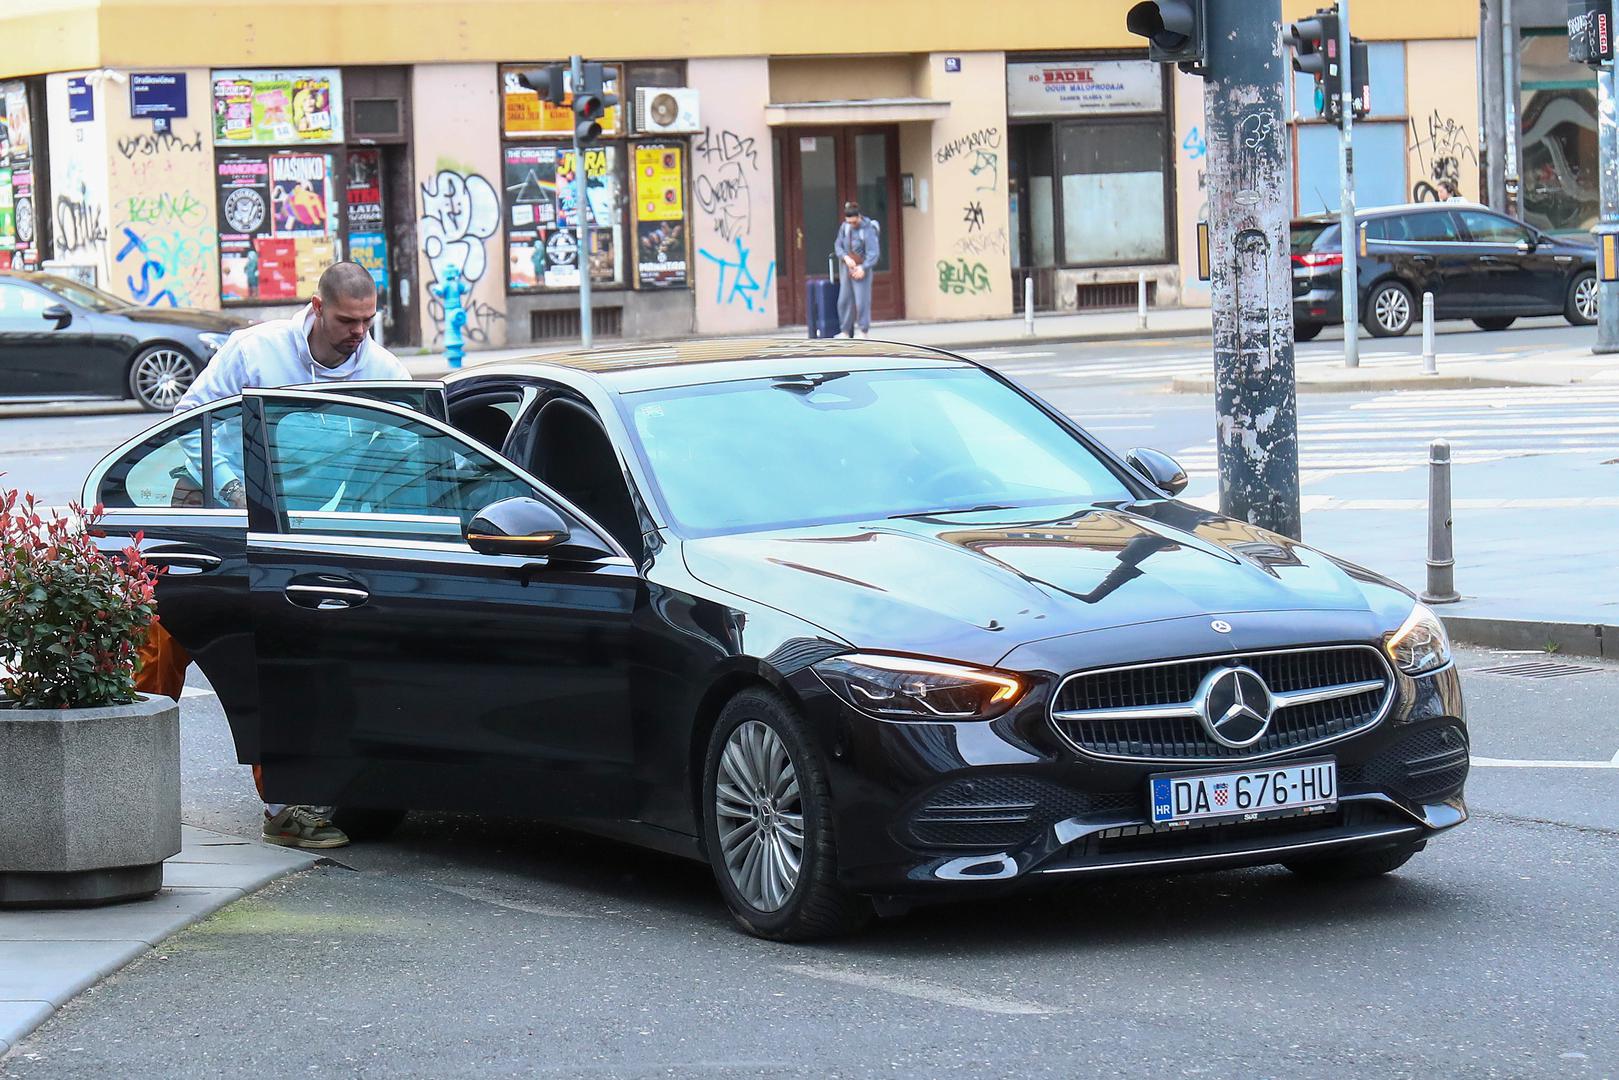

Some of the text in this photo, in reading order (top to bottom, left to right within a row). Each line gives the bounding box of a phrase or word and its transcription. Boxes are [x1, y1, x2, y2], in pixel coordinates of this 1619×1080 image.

[1043, 70, 1094, 82] BADEL
[1070, 83, 1124, 91] MALOPRODAJA
[1174, 766, 1333, 815] DA 676-HU
[1156, 804, 1170, 815] HR
